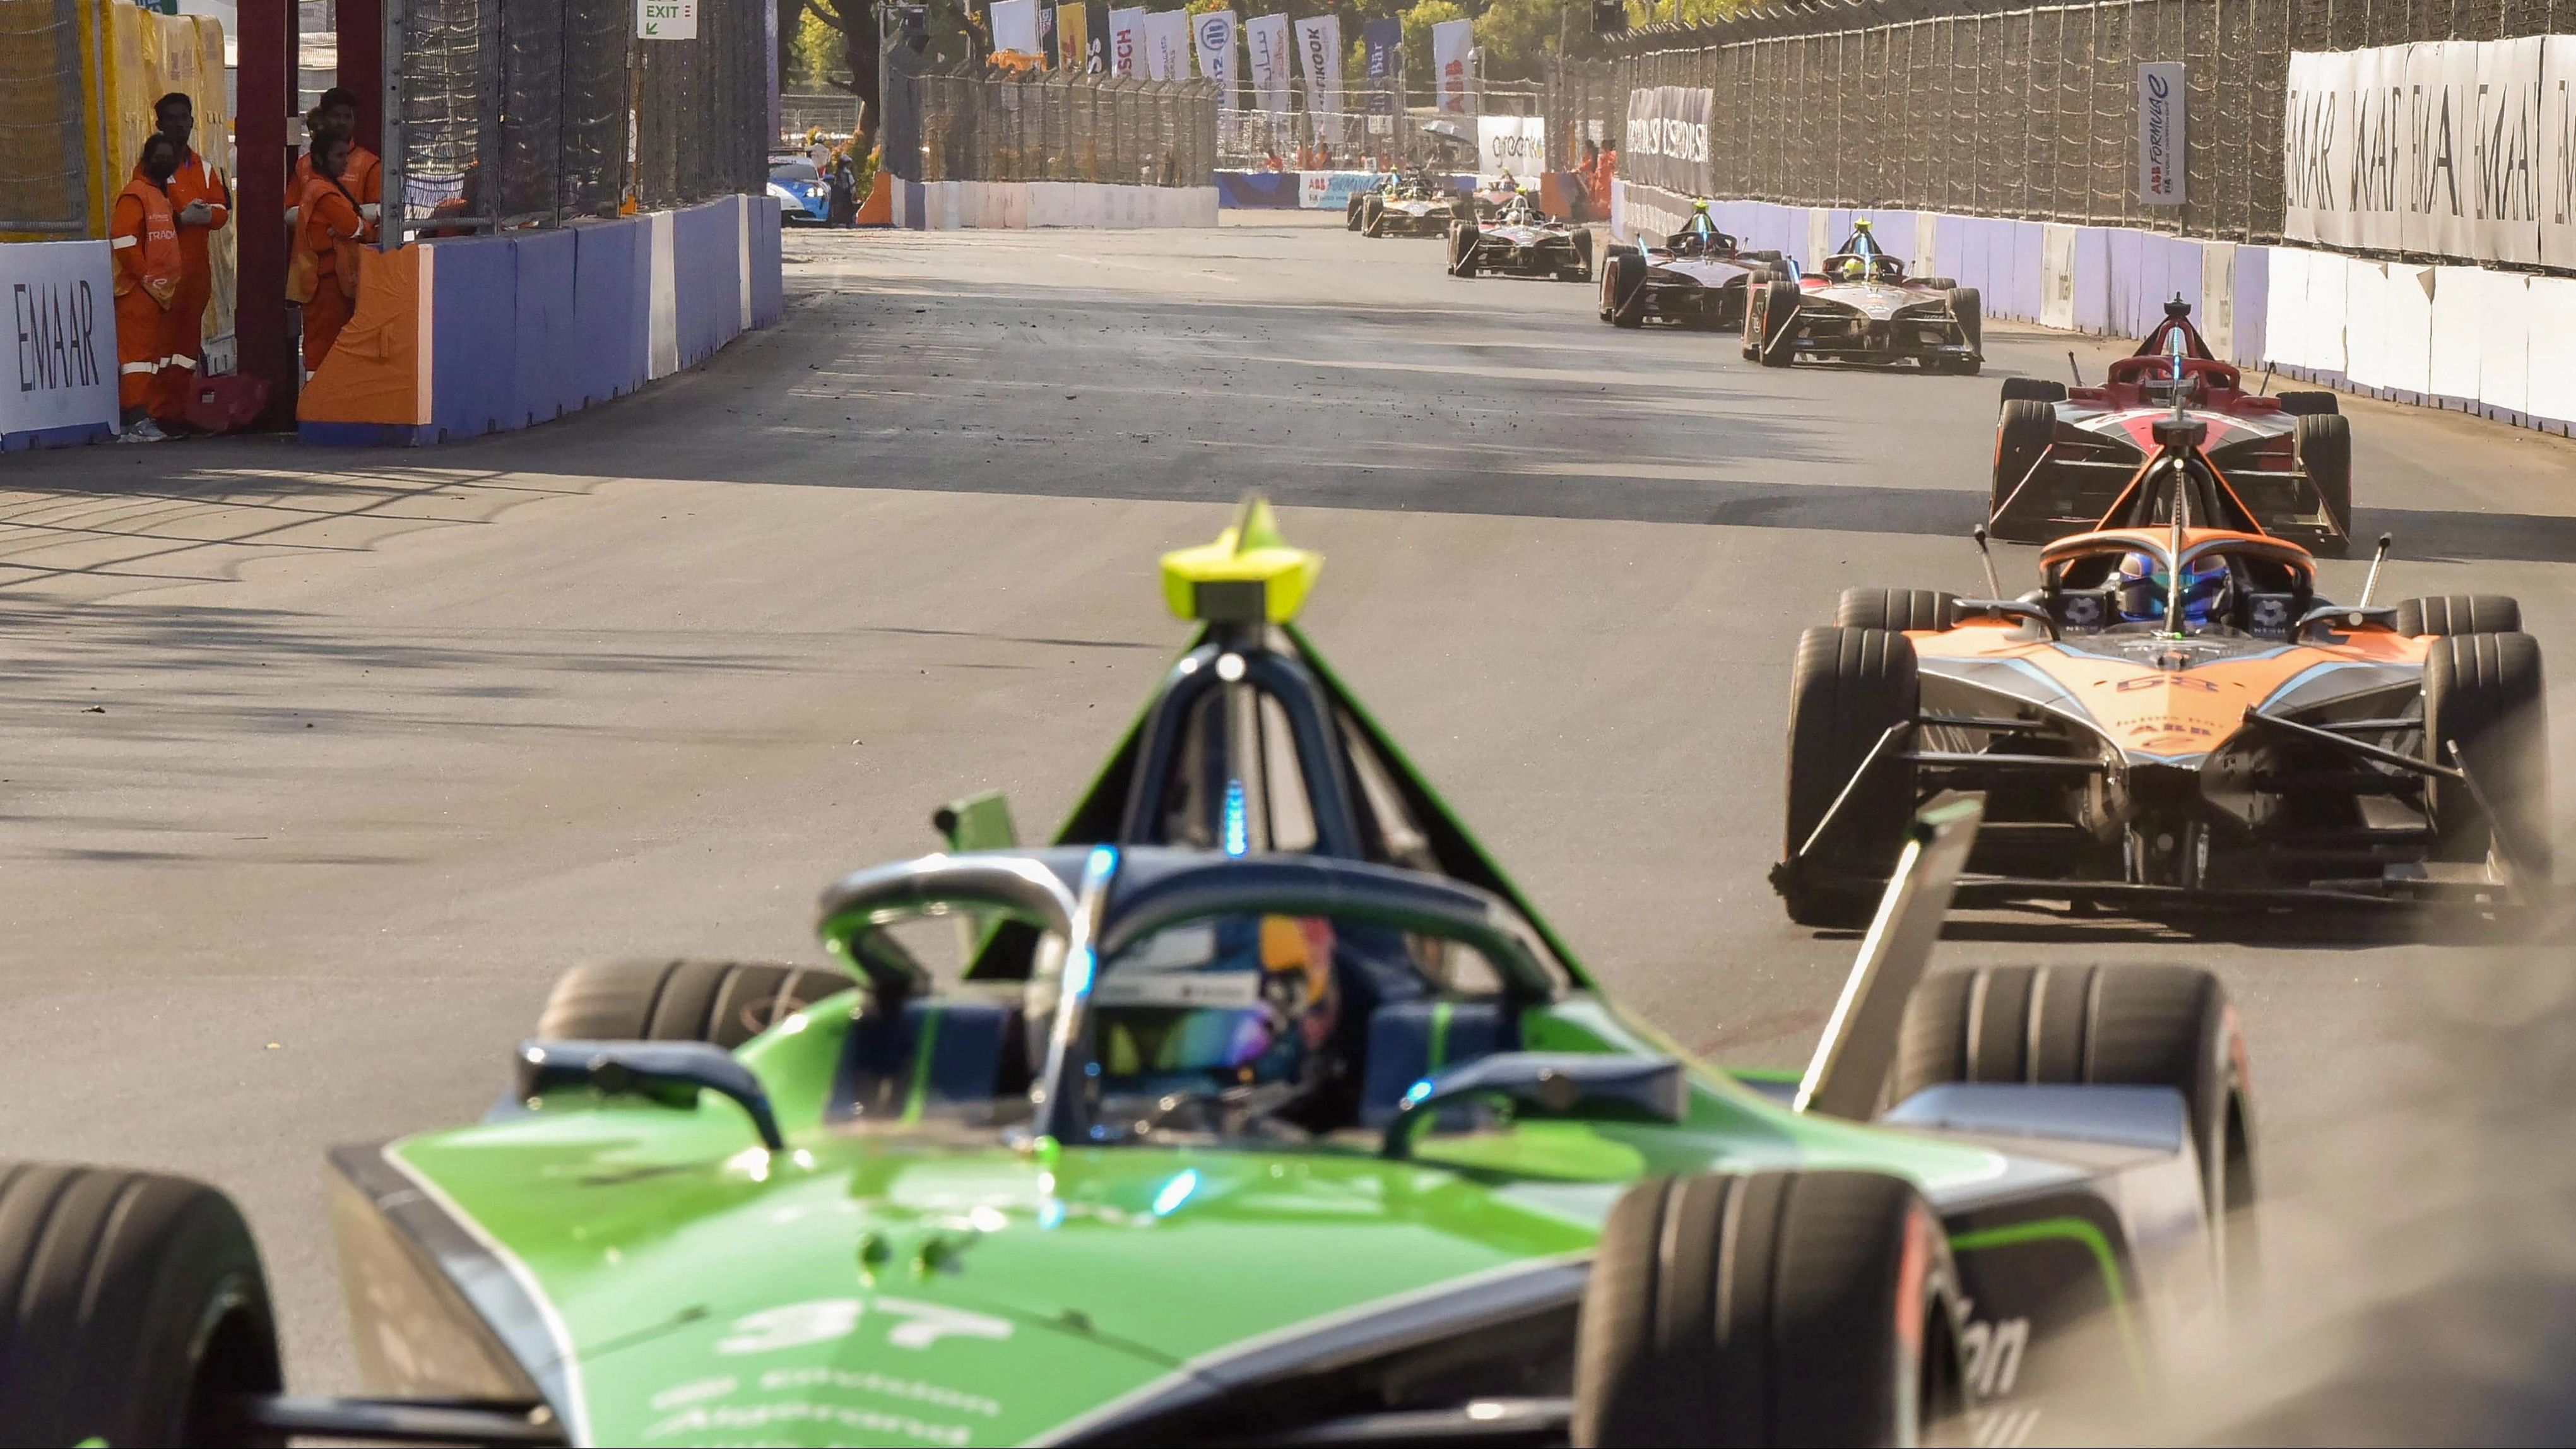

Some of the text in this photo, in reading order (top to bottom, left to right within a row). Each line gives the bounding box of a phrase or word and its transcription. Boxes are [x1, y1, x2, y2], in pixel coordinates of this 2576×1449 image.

[646, 6, 679, 18] EXIT
[2149, 97, 2163, 164] FORMULA
[2151, 166, 2161, 194] ABB
[14, 280, 99, 392] EMAAR
